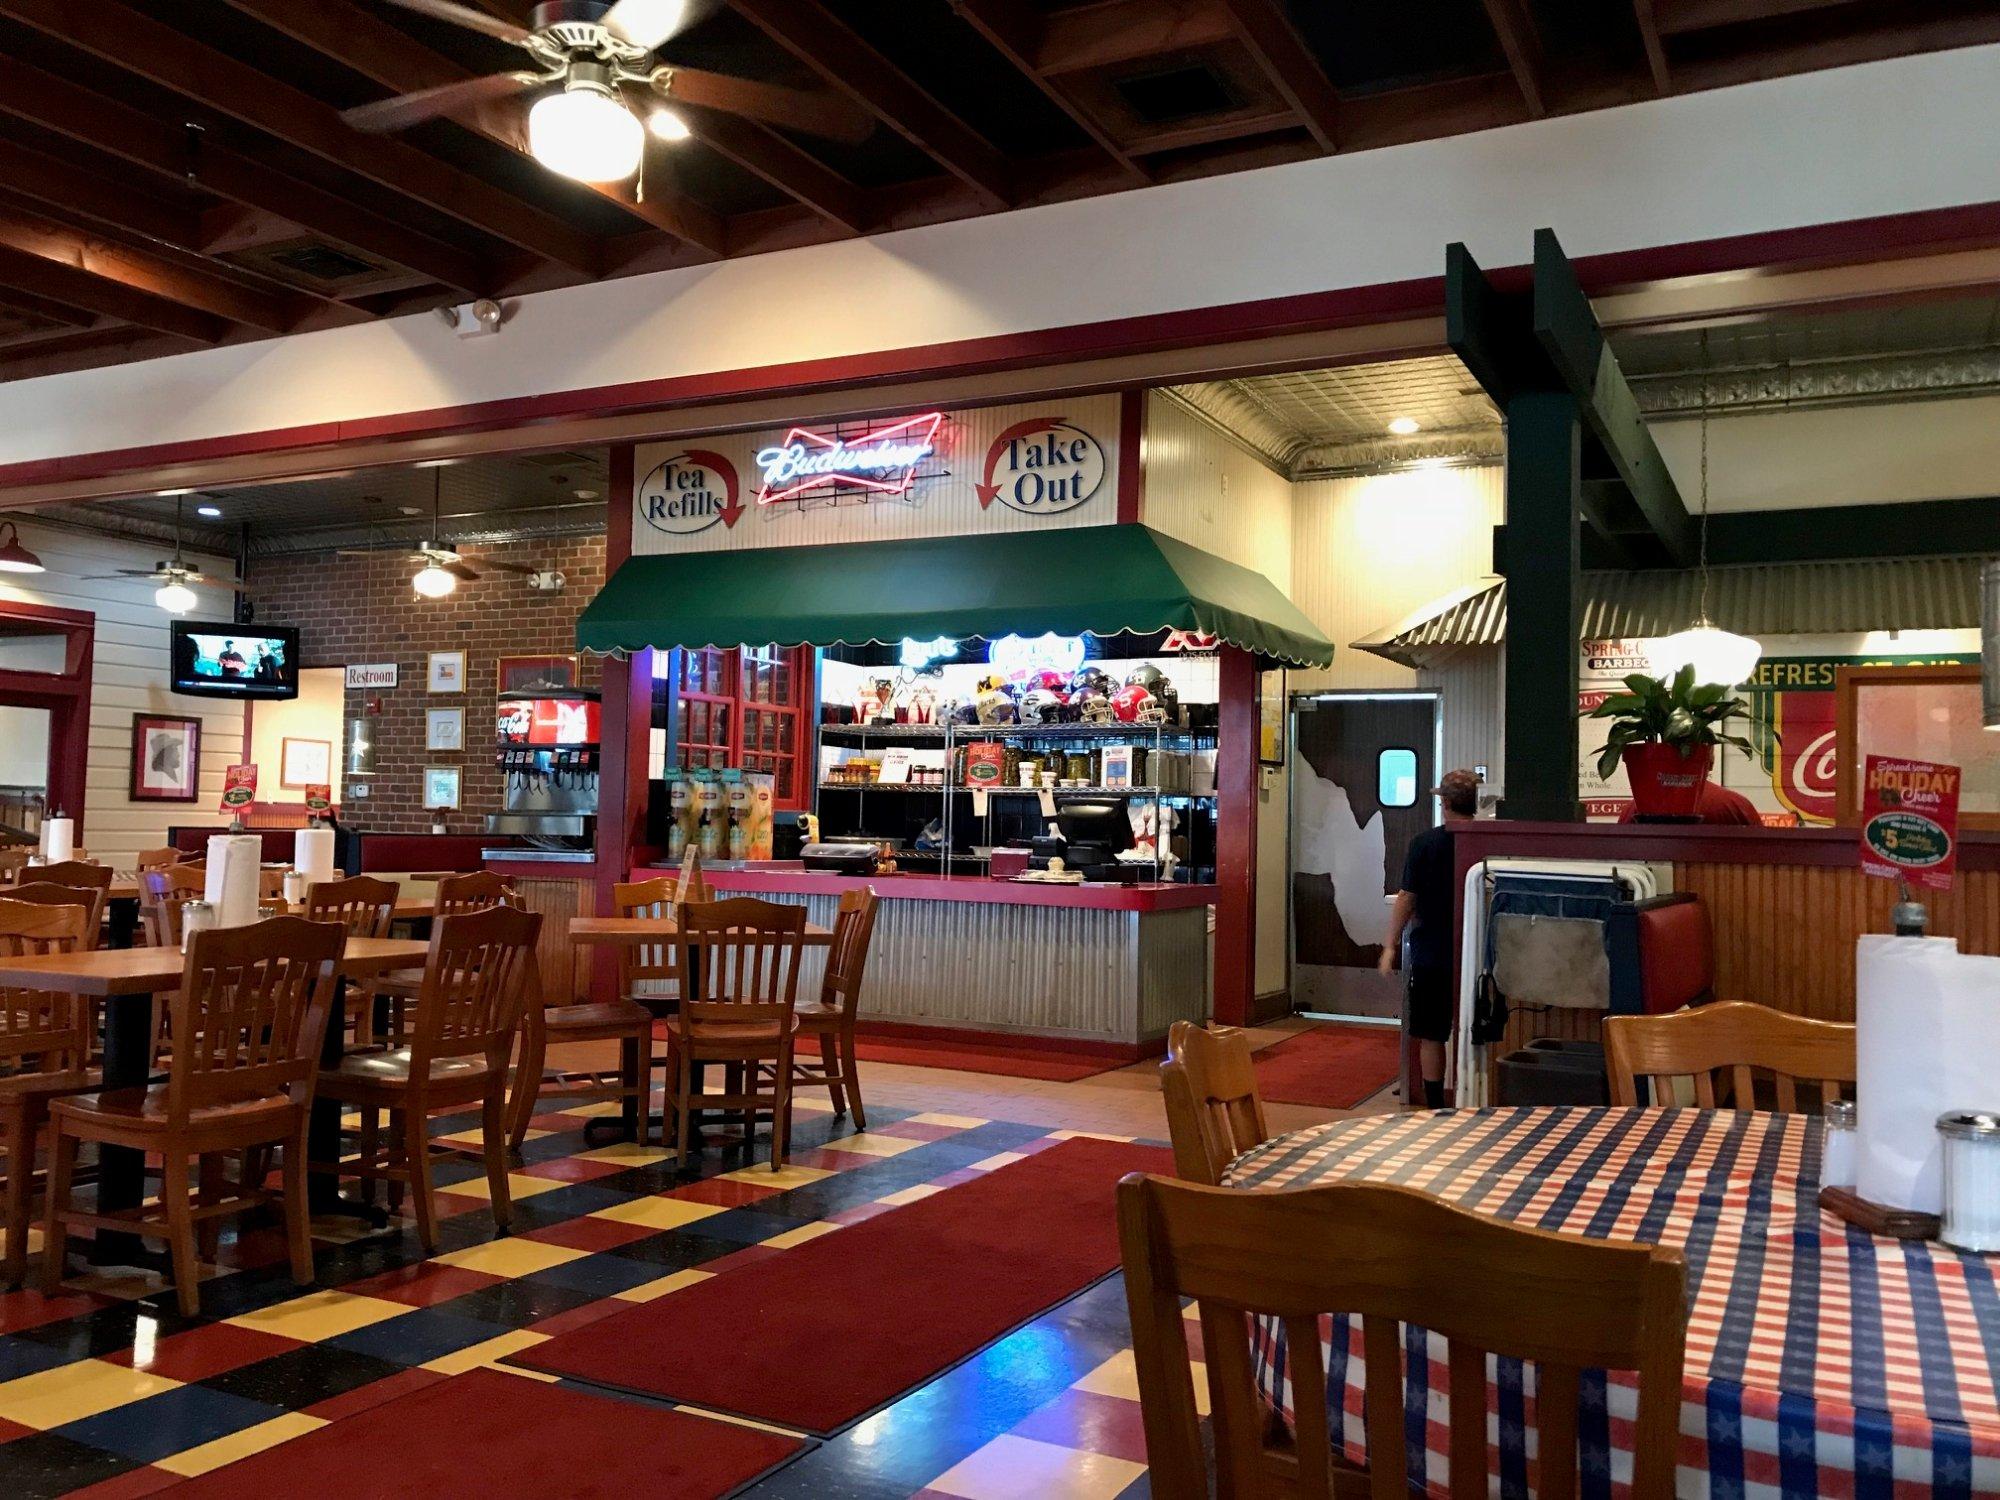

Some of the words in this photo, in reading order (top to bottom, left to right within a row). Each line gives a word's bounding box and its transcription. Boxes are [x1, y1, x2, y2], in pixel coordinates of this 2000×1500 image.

[1001, 433, 1087, 471] Take
[659, 464, 705, 490] Tea
[1015, 470, 1083, 505] Out
[648, 491, 723, 519] Refills
[1582, 641, 1631, 657] SPRING
[350, 667, 394, 684] Restroom
[1748, 663, 1847, 686] EFRES
[1586, 781, 1611, 789] Whole
[1869, 769, 1958, 794] HOLIDAY
[1900, 786, 1942, 804] Cheer
[1586, 803, 1628, 813] EGE
